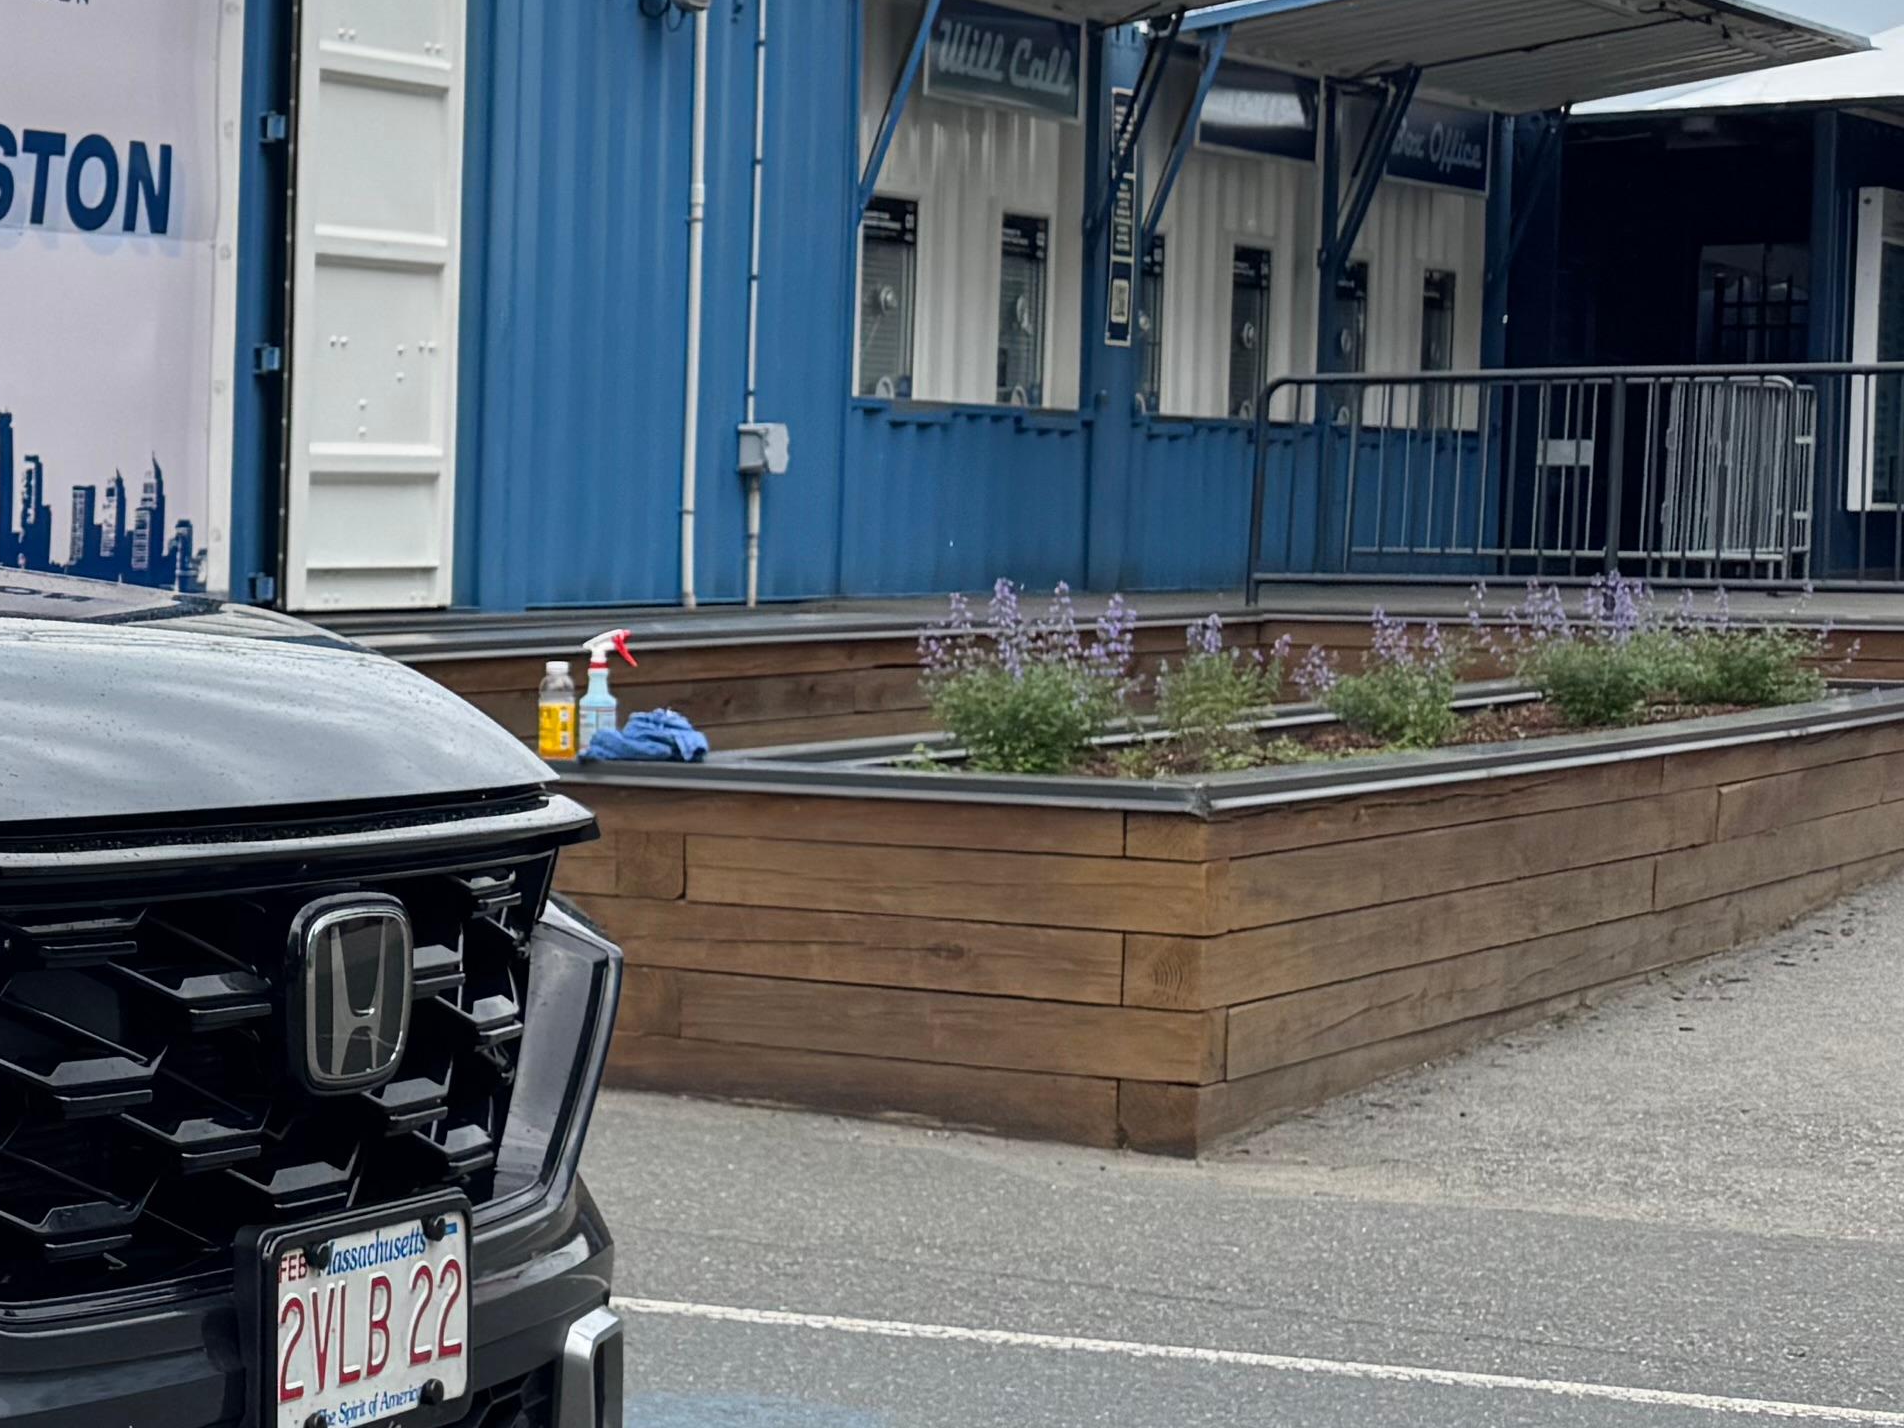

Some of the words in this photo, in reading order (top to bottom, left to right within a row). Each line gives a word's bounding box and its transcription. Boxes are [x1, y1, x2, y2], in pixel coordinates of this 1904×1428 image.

[939, 19, 1004, 82] Will
[1010, 38, 1071, 95] Call
[1430, 122, 1481, 173] Office
[279, 1253, 307, 1283] FEB
[280, 1270, 392, 1403] 2VLB
[408, 1254, 463, 1368] 22
[339, 1396, 366, 1426] Spirit
[369, 1392, 380, 1415] of
[380, 1384, 422, 1412] Americ
